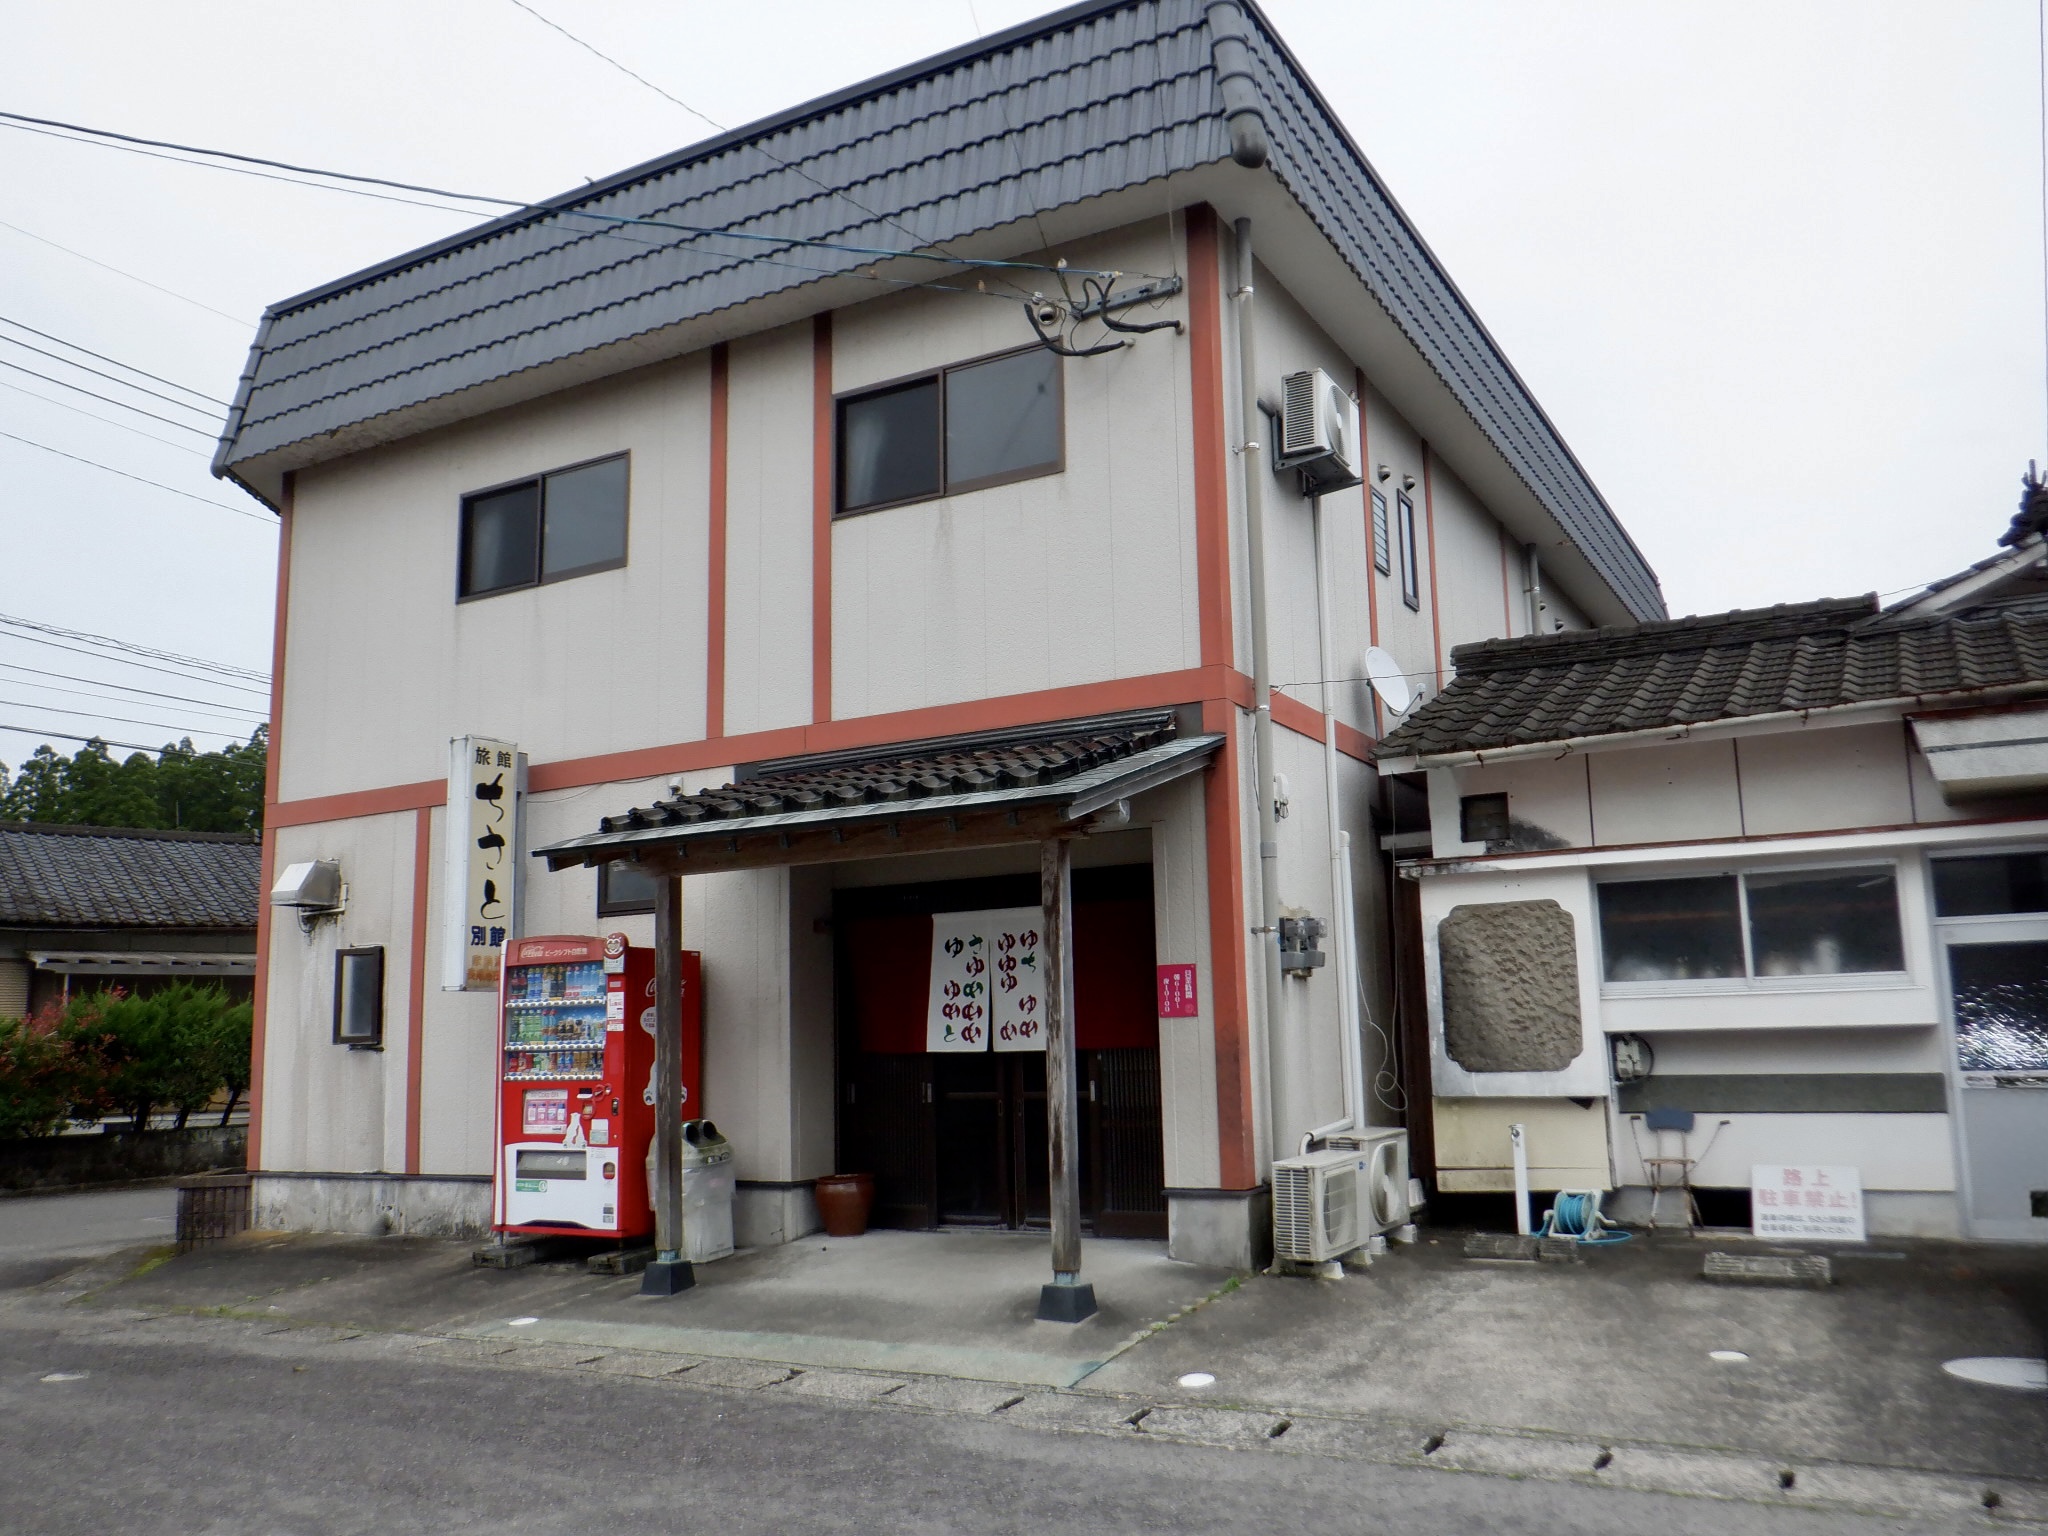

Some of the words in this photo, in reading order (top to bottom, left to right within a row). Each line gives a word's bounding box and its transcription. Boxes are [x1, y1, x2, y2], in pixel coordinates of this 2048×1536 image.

[474, 747, 512, 769] 旅館
[475, 772, 506, 920] ちさと
[470, 925, 506, 948] 別館
[1783, 1168, 1830, 1186] 路上
